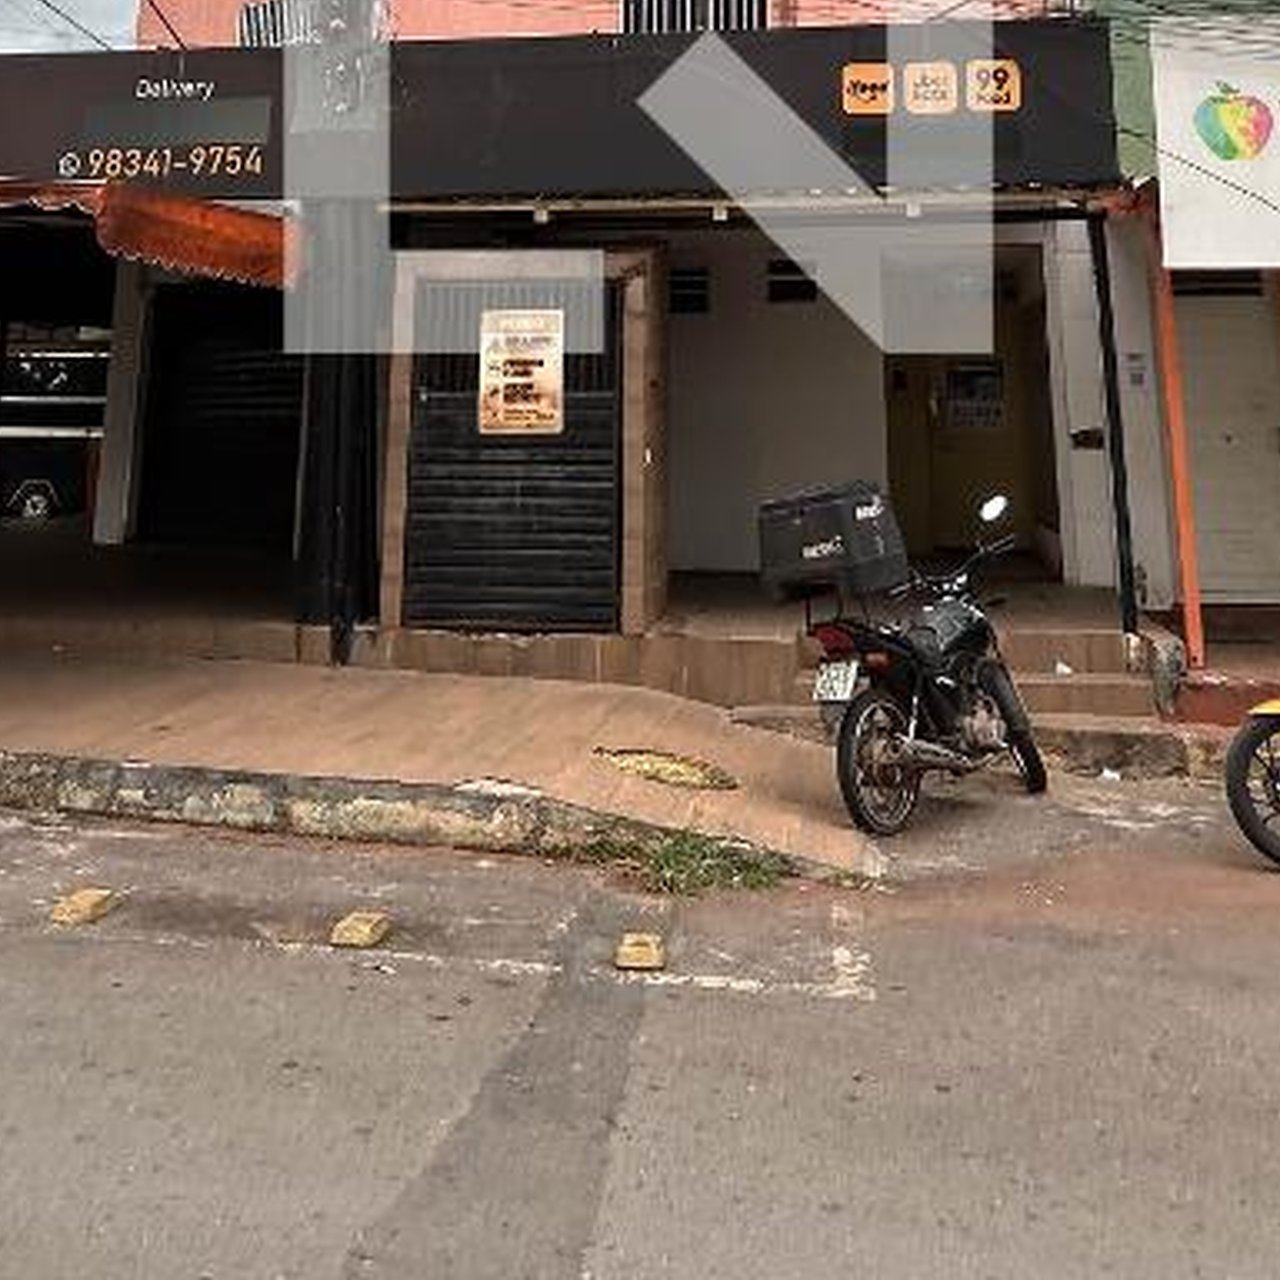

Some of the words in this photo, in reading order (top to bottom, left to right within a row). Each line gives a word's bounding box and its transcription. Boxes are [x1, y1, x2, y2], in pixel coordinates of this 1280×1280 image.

[135, 78, 216, 101] Delivery
[976, 68, 1009, 90] 99
[88, 146, 263, 176] 98341-9754
